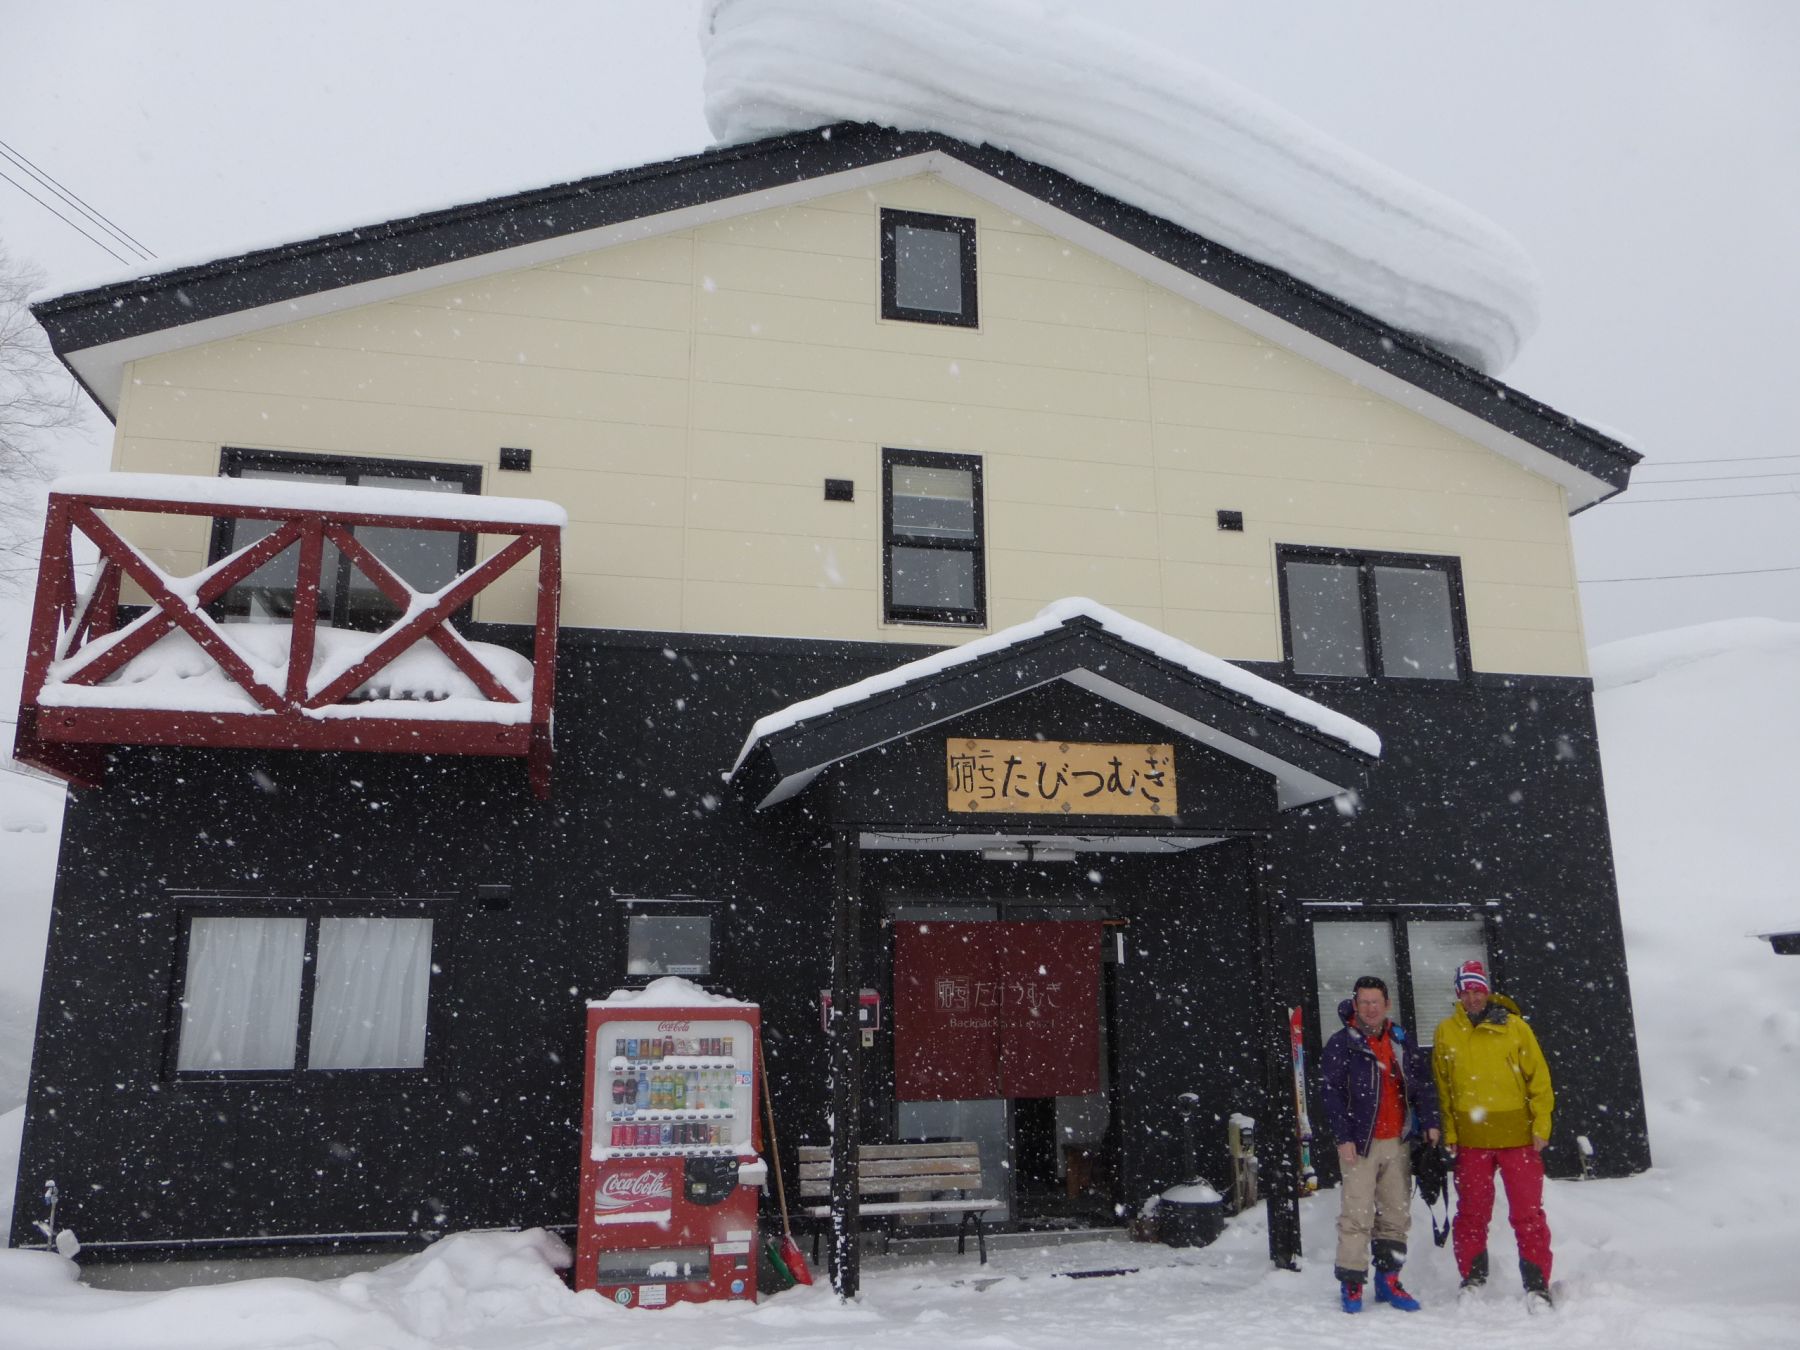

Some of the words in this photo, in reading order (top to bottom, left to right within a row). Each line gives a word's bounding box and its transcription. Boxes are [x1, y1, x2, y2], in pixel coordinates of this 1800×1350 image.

[1002, 755, 1170, 803] たびつむぎ
[657, 1020, 690, 1032] Coca-Cola
[602, 1170, 667, 1195] Coca-Cola
